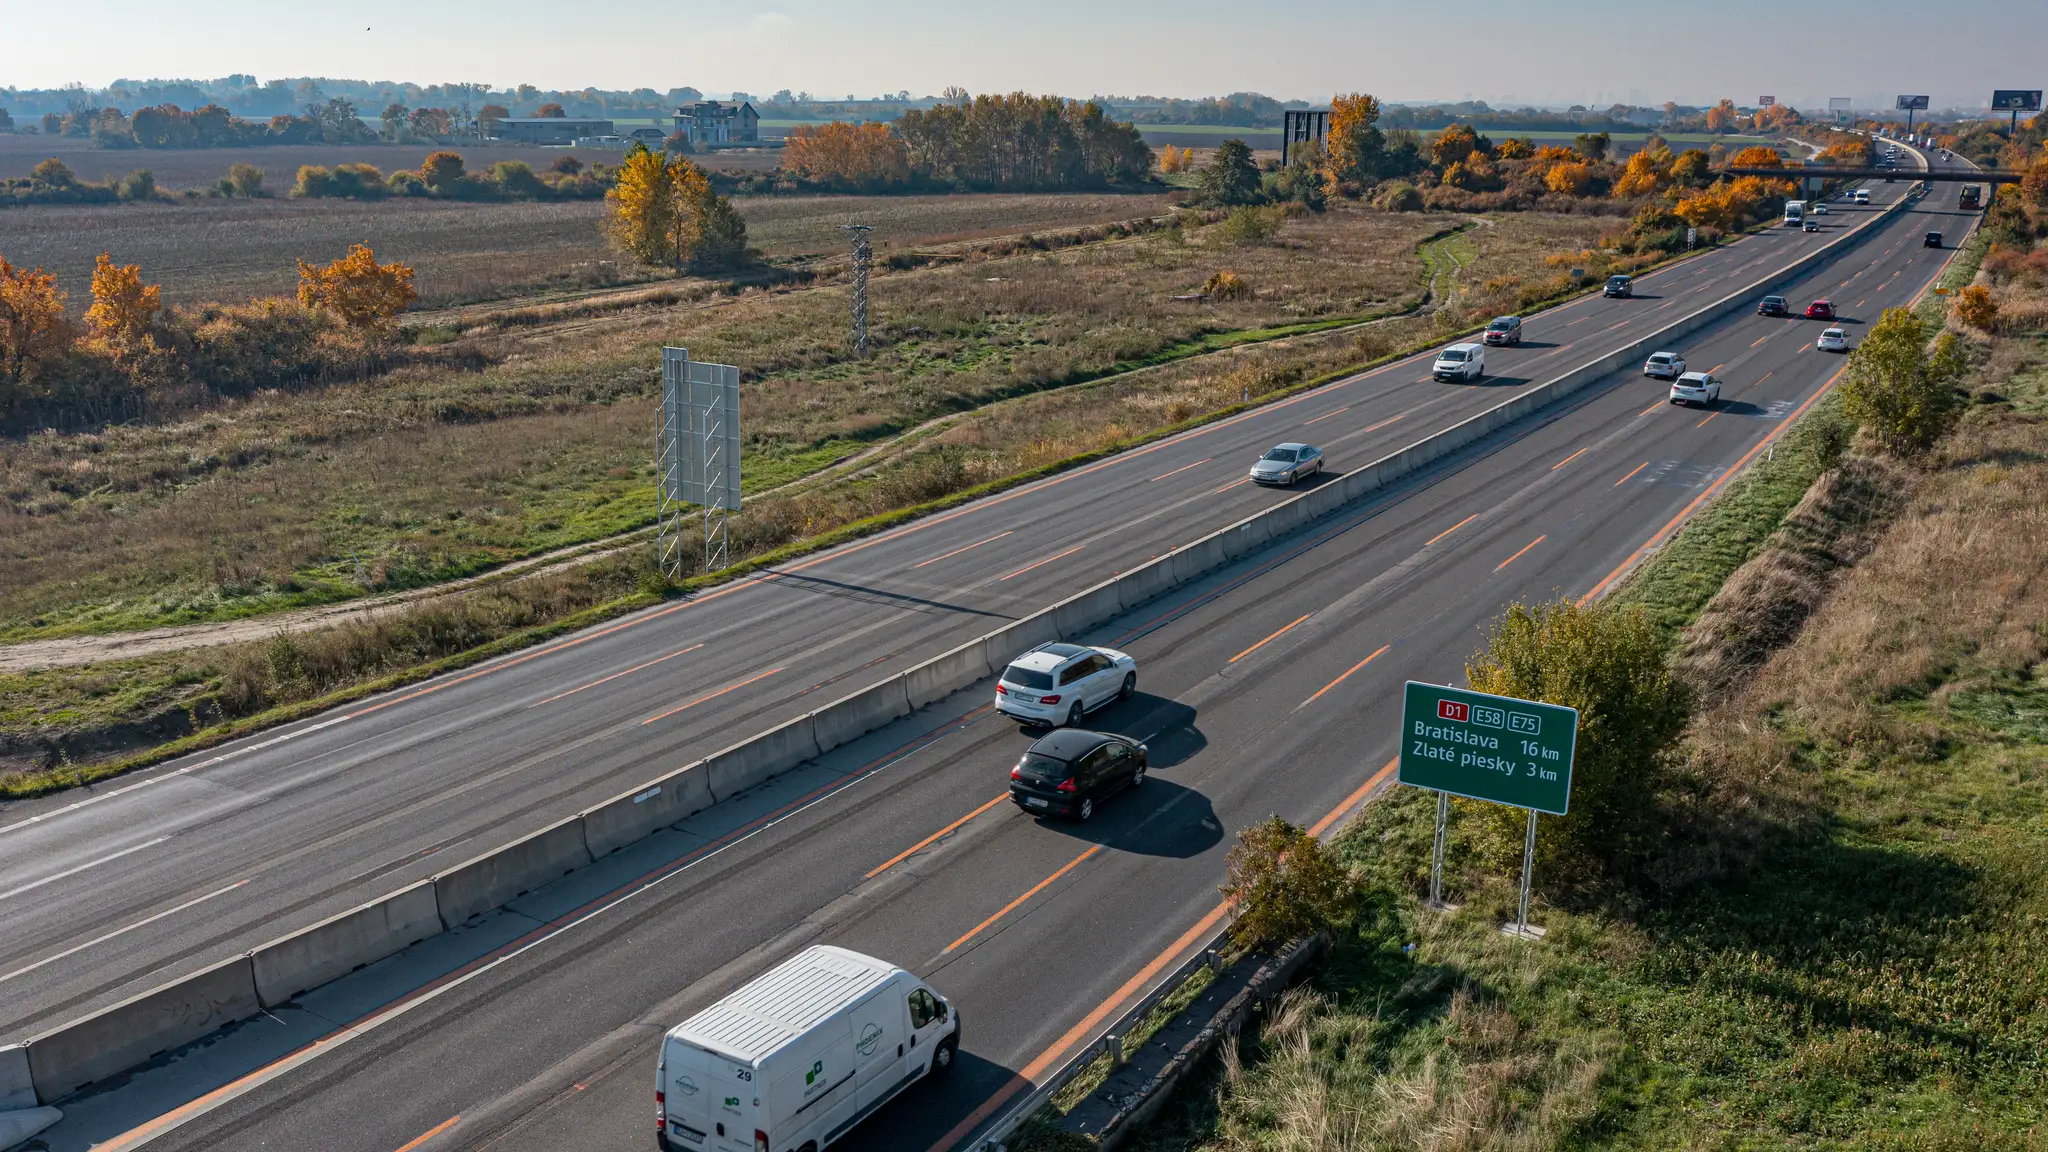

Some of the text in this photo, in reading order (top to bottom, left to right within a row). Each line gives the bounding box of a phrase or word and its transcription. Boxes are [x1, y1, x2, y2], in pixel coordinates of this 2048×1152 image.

[1445, 704, 1536, 731] D1 E58 E75
[1414, 720, 1559, 761] Bratislava 16 km
[1412, 740, 1557, 782] Zlaté piesky 3 km
[855, 1026, 884, 1051] PHOENIX
[736, 1068, 752, 1082] 29
